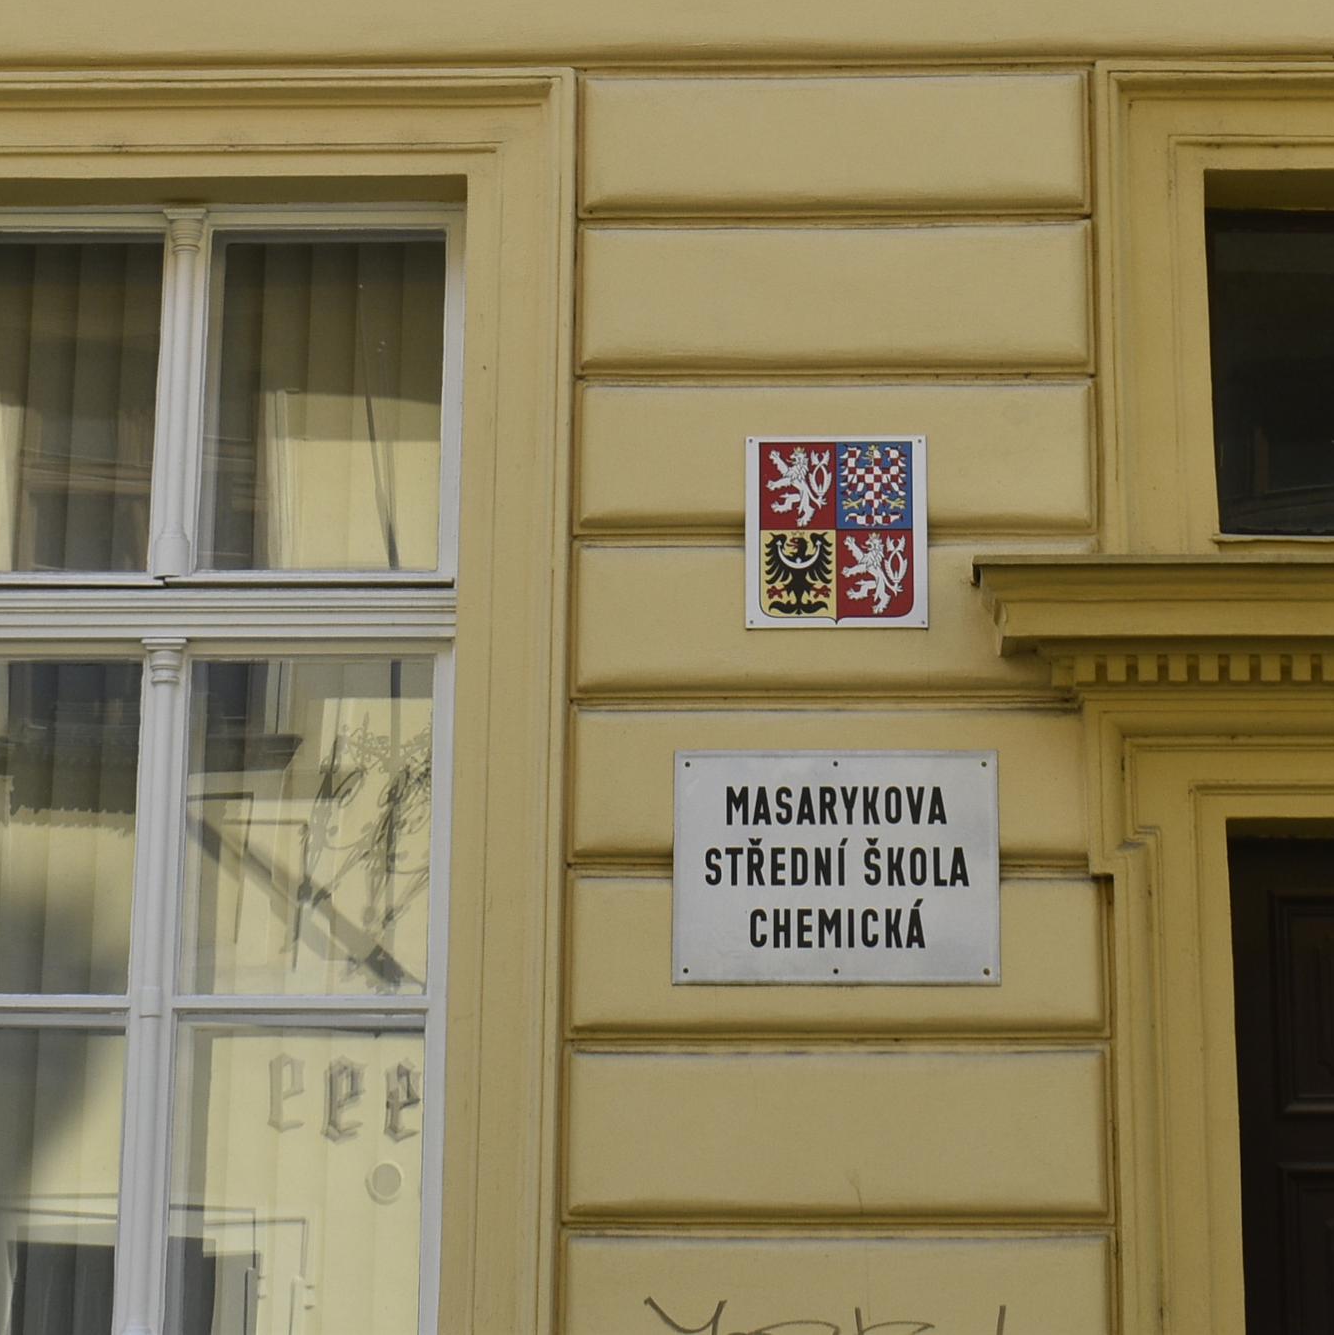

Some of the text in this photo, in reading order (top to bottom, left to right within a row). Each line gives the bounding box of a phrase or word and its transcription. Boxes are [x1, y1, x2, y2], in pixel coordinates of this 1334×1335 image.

[725, 785, 948, 826] MASARYKOVA
[704, 837, 970, 887] STŘEDNÍ ŠKOLA
[749, 898, 926, 949] CHEMICKÁ
